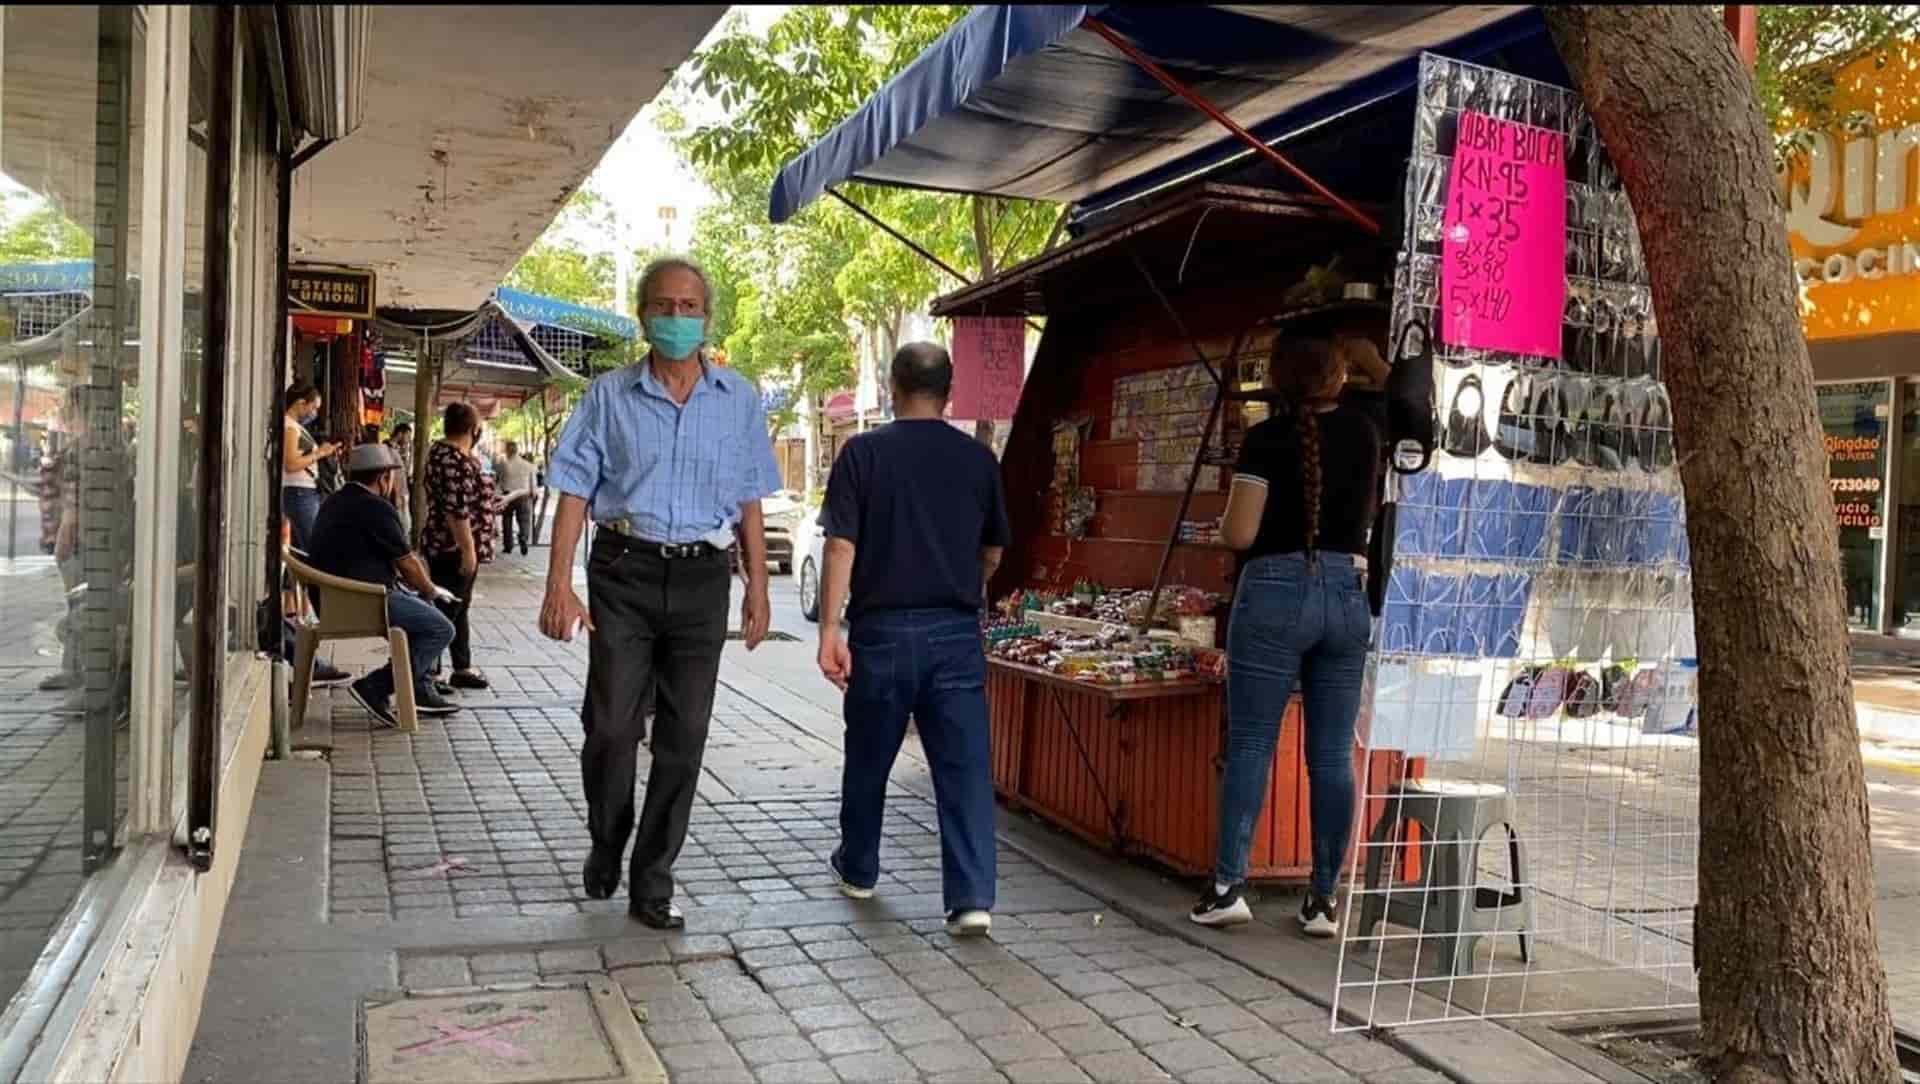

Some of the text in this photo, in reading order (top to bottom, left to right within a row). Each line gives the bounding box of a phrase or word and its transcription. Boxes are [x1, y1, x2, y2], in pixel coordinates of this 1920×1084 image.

[1513, 124, 1560, 168] BOCA
[1457, 155, 1529, 199] KN-95
[289, 279, 355, 292] ESTERN
[301, 290, 355, 304] UNION
